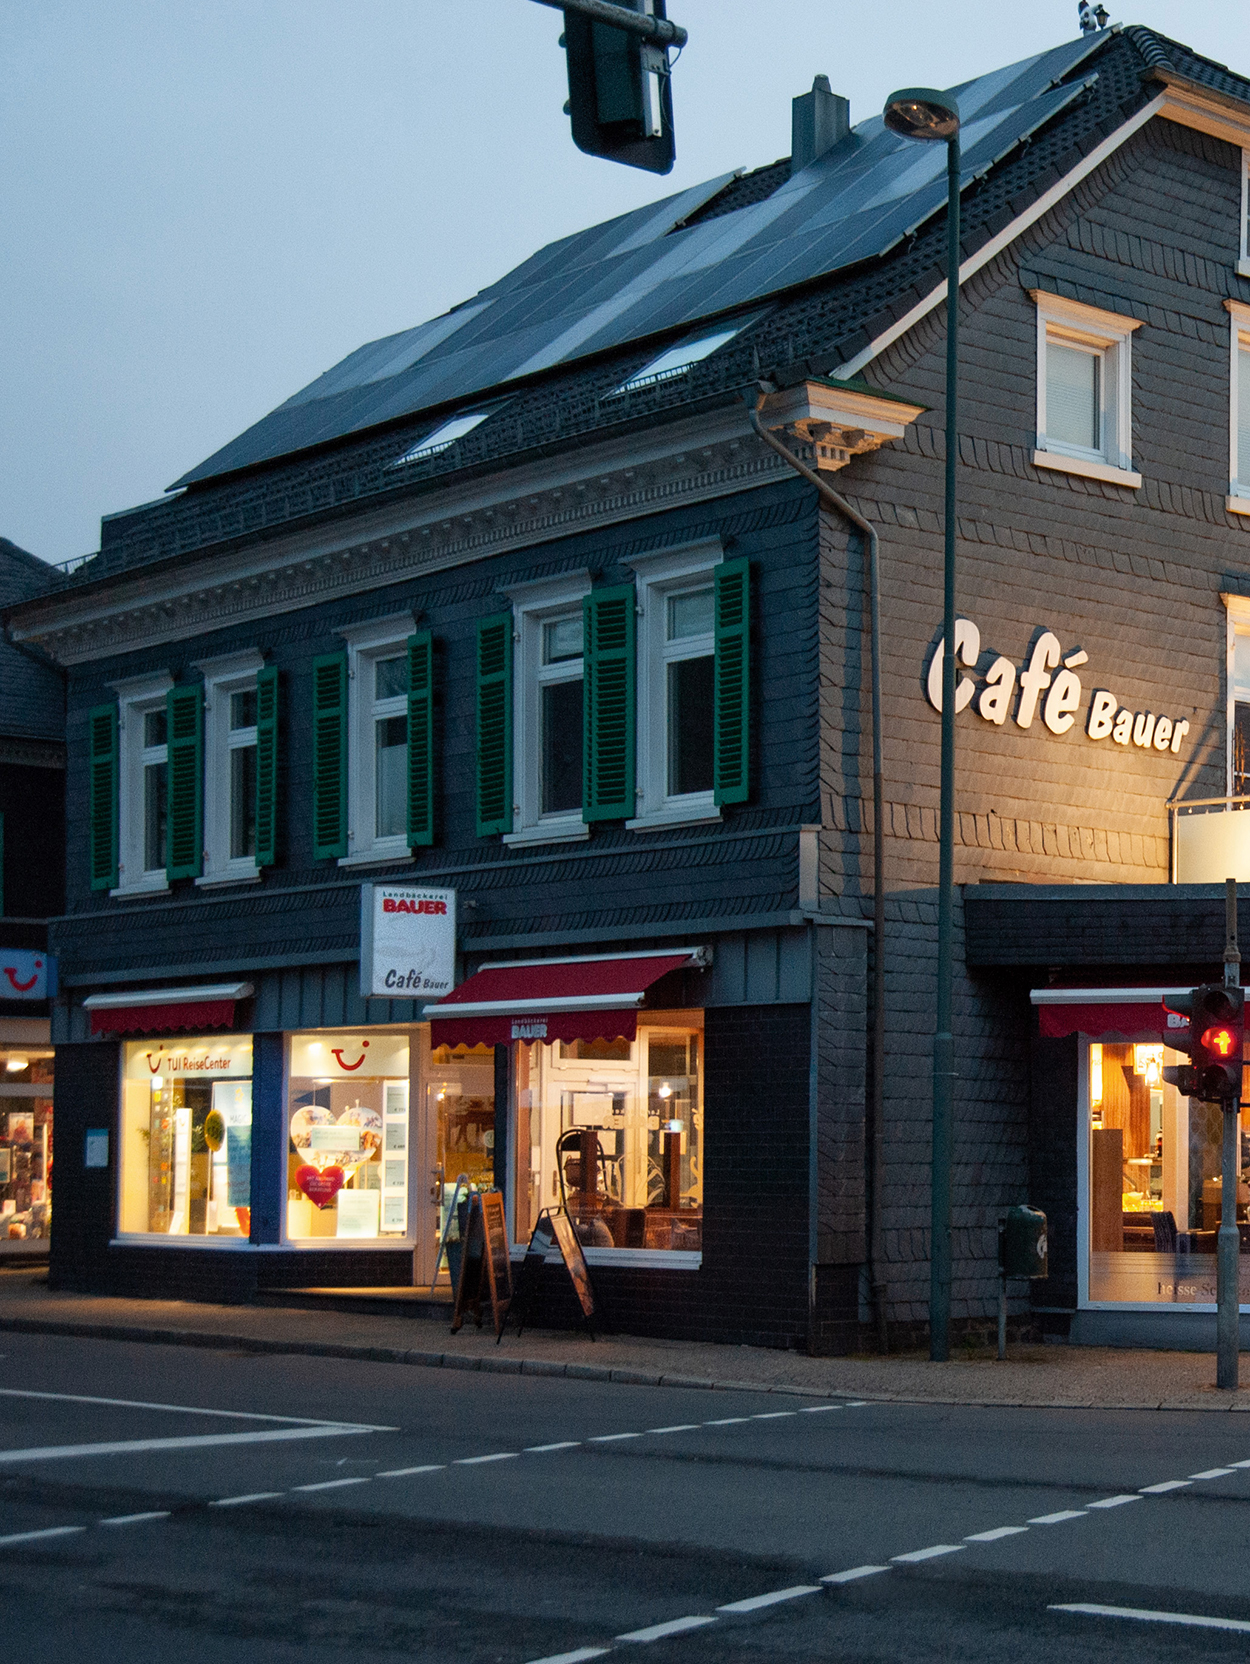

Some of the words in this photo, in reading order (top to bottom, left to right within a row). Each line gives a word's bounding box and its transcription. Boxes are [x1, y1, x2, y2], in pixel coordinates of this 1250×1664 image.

[928, 618, 1089, 735] Café
[1088, 691, 1190, 754] Bauer
[383, 891, 448, 900] Landbäckerei
[383, 898, 448, 915] BAUER
[385, 969, 423, 989] Café
[423, 979, 449, 989] Bauer
[511, 1024, 548, 1040] BAUER
[168, 1058, 181, 1071] TUI
[183, 1056, 231, 1070] ReiseCenter
[1158, 1282, 1197, 1296] heisse
